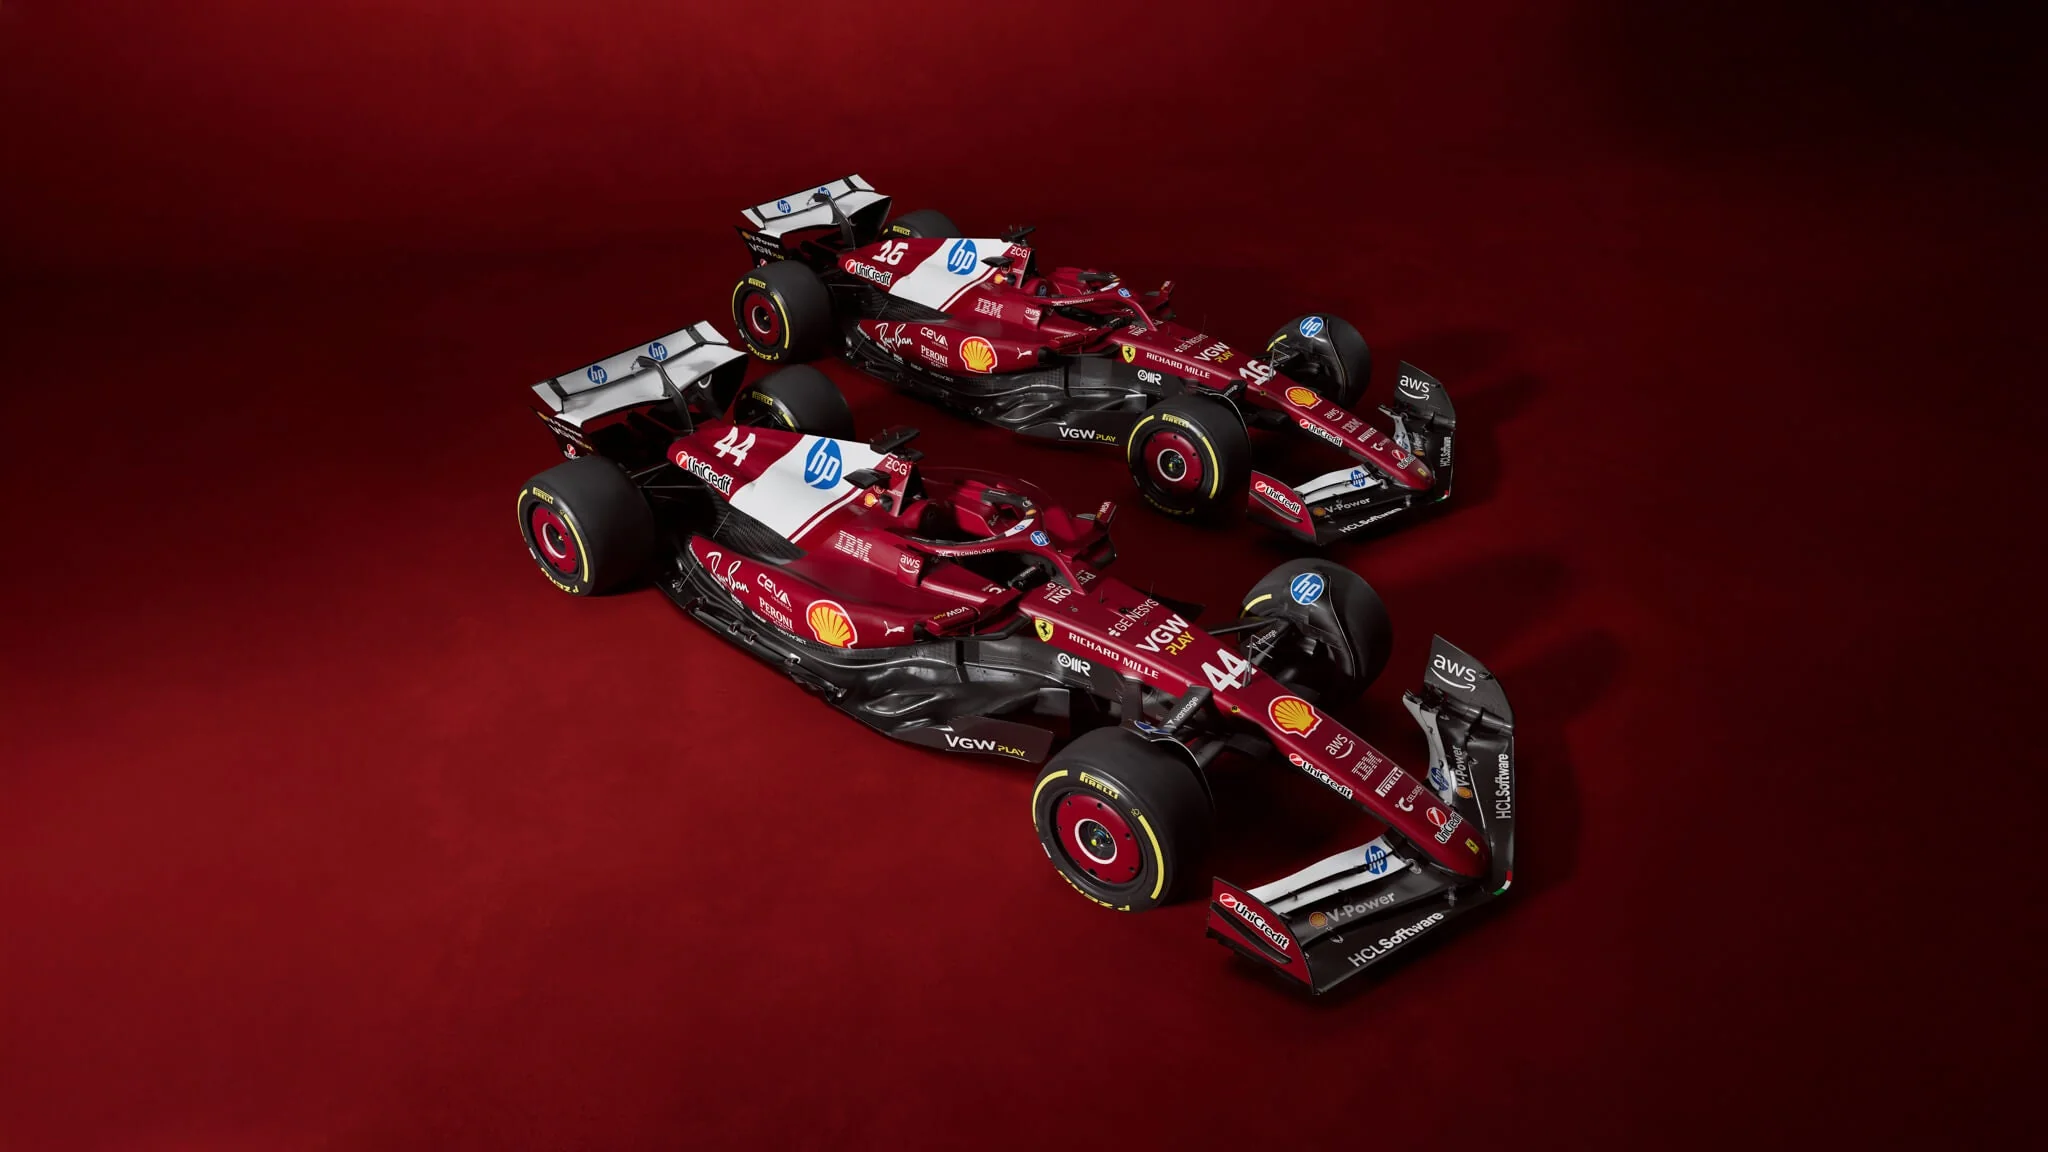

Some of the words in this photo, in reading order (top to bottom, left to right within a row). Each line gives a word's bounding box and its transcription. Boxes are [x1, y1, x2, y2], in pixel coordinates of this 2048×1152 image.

[872, 239, 908, 266] 16
[949, 239, 976, 274] hp
[1010, 245, 1028, 259] ZCG
[856, 263, 892, 287] UniCredit
[974, 297, 1003, 319] IBM
[1302, 317, 1322, 337] hp
[650, 342, 666, 361] hp
[920, 344, 949, 365] PERONI
[1146, 351, 1182, 371] RICHARD
[1184, 365, 1211, 380] MILLE
[1193, 341, 1231, 363] VGW
[589, 366, 606, 385] hp
[1239, 360, 1277, 386] 16
[1400, 375, 1430, 394] aws
[713, 426, 757, 467] 44
[1058, 427, 1096, 441] VGW
[1096, 433, 1117, 443] PLAY
[1308, 421, 1344, 447] UniCredit
[687, 455, 734, 496] UniCredit
[806, 438, 841, 489] hp
[884, 456, 909, 477] ZCG
[1265, 486, 1301, 515] UniCredit
[1324, 497, 1371, 514] V-Power
[835, 529, 873, 564] IBM
[953, 547, 996, 558] TECHNOLOGY
[900, 554, 922, 569] aws
[1293, 574, 1322, 604] hp
[759, 596, 793, 630] PERONI
[1135, 613, 1190, 653] VGW
[1164, 631, 1196, 656] PLAY
[1067, 630, 1120, 662] RICHARD
[1122, 652, 1160, 680] MILLE
[1433, 653, 1477, 683] aws
[1200, 648, 1258, 692] 44
[944, 733, 997, 752] VGW
[997, 744, 1027, 758] PLAY
[1325, 733, 1349, 757] aws
[1351, 750, 1383, 782] IBM
[1079, 771, 1120, 801] PIRELLI
[1302, 761, 1353, 801] UniCredit
[1374, 765, 1404, 798] PIRELLI
[1495, 753, 1512, 820] HCLSoftware
[1434, 811, 1463, 844] UniCredit
[1366, 846, 1388, 875] hp
[1326, 891, 1397, 925] V-Power
[1234, 902, 1290, 951] UniCredit
[1346, 910, 1446, 968] HCLSoftware
